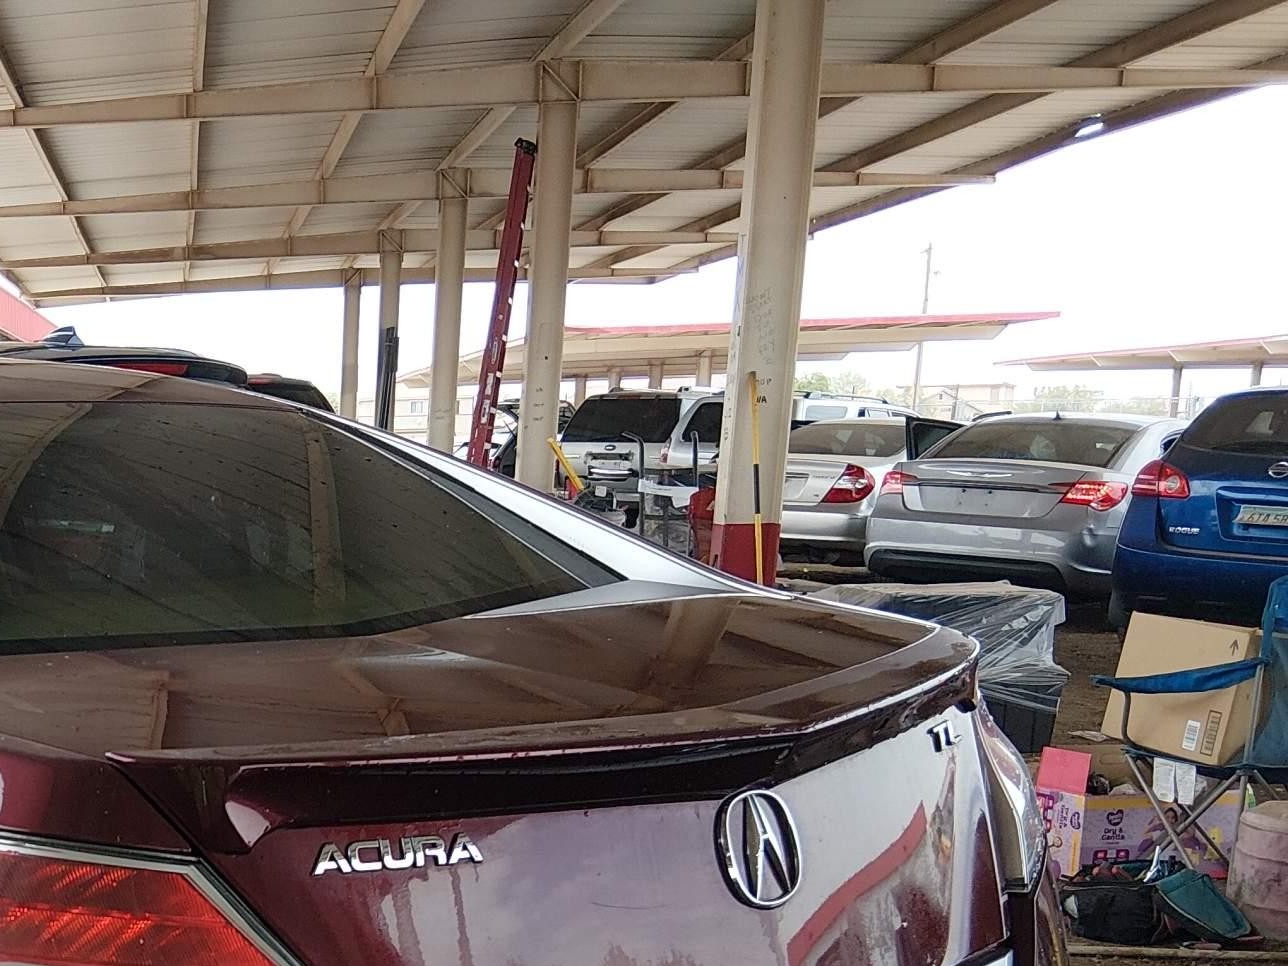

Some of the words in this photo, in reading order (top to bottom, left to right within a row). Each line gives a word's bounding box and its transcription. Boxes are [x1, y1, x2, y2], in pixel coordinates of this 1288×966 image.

[1169, 526, 1200, 535] ROGUE
[927, 720, 962, 752] TL
[1104, 827, 1117, 836] Dry
[312, 832, 484, 876] ACURA
